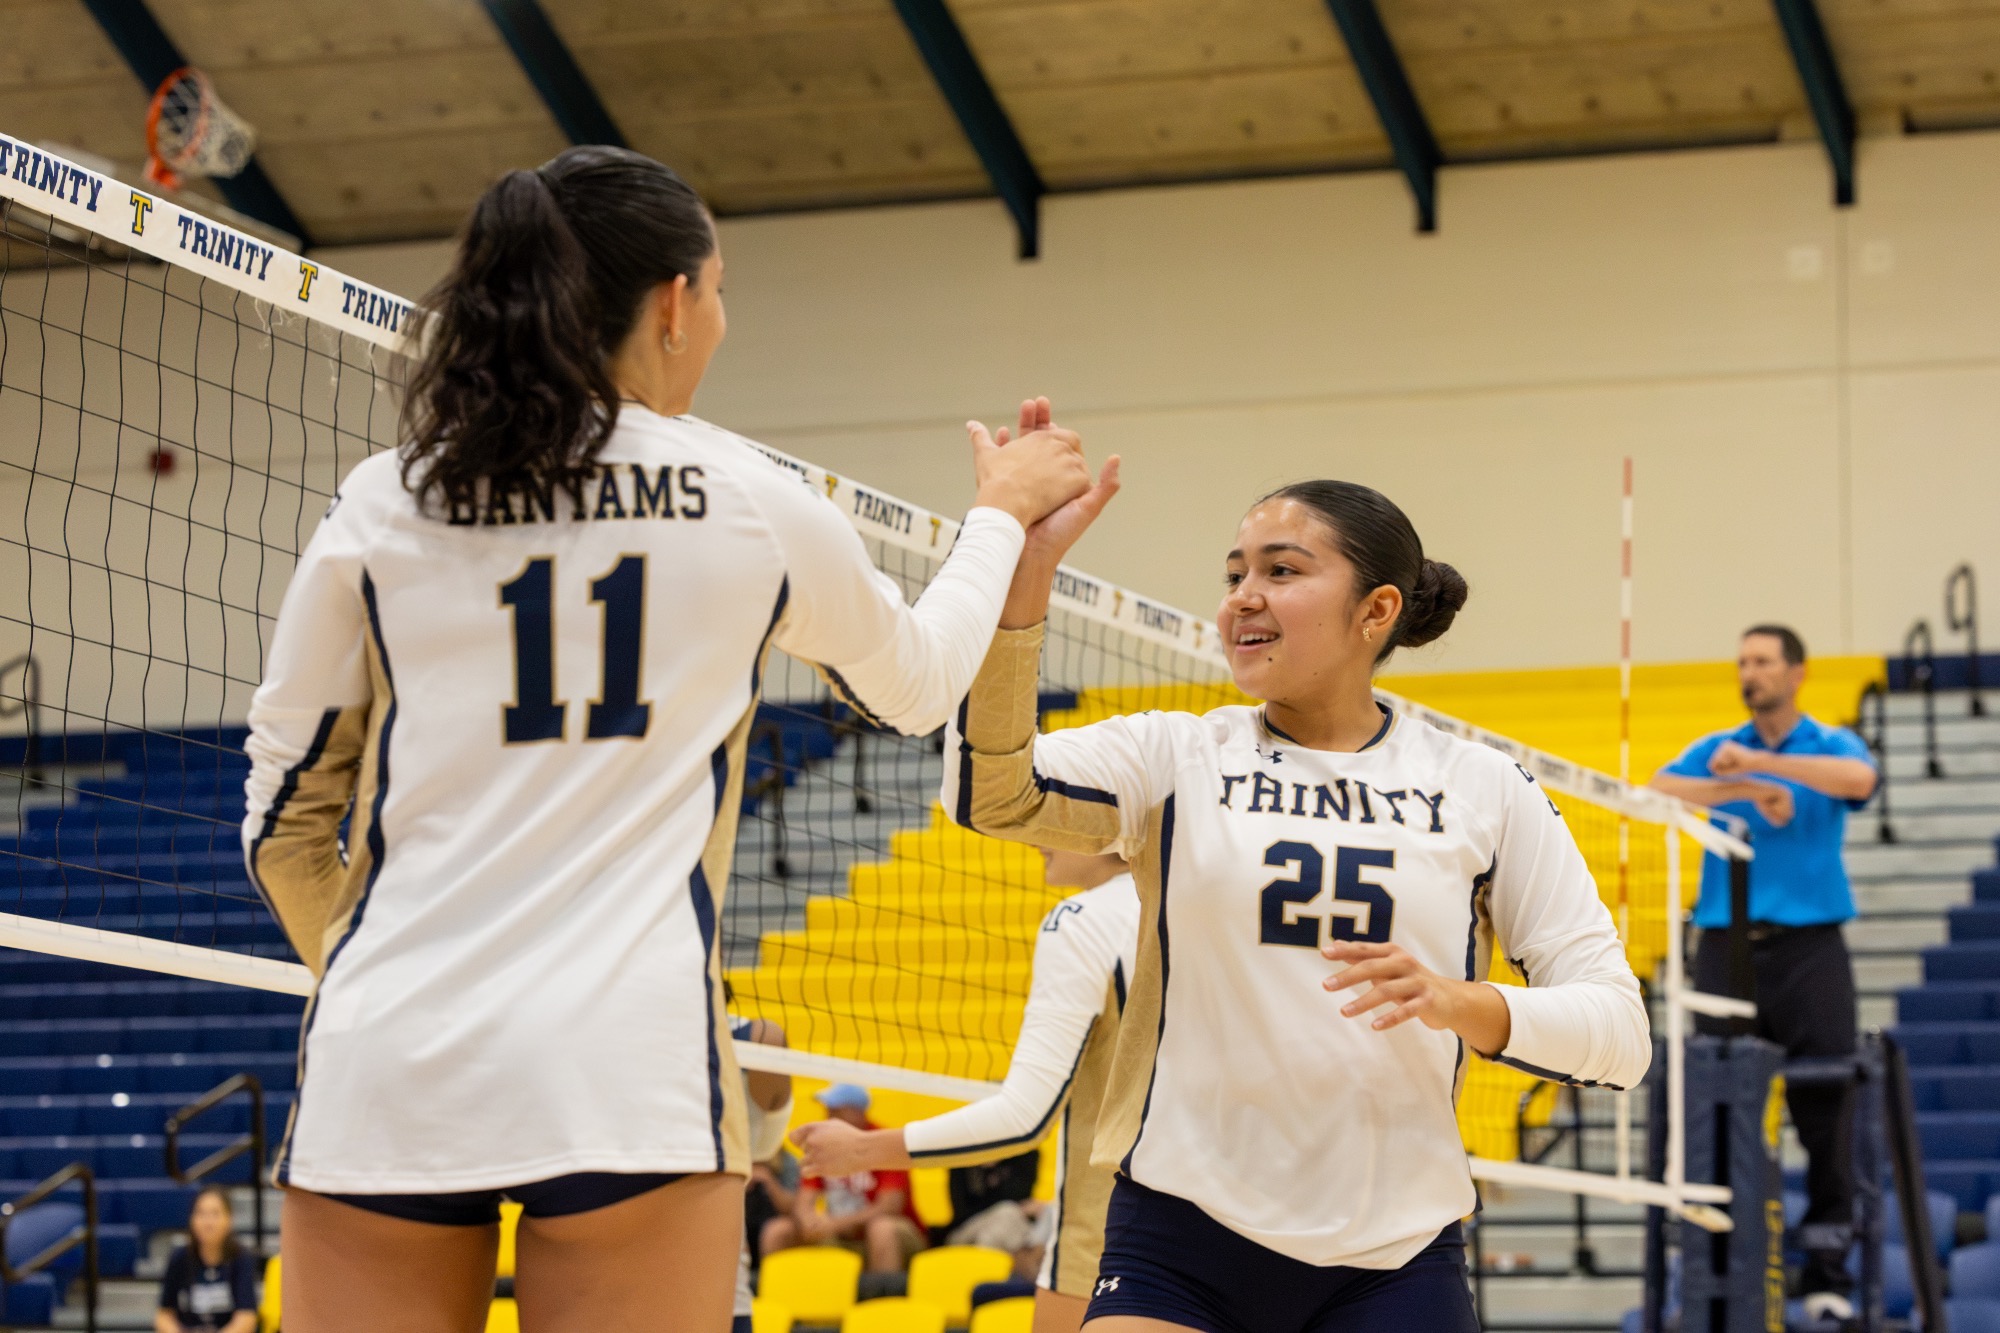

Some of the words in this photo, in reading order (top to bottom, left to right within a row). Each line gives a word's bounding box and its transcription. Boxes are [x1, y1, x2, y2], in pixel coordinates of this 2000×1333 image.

[0, 139, 103, 213] TRINITY
[130, 189, 153, 237] T
[177, 214, 274, 282] TRINITY
[299, 260, 318, 302] T
[342, 281, 417, 337] TRINIT
[854, 488, 913, 534] TRINITY
[497, 553, 654, 746] 11
[1219, 769, 1446, 834] TRINITY
[1258, 838, 1397, 951] 25
